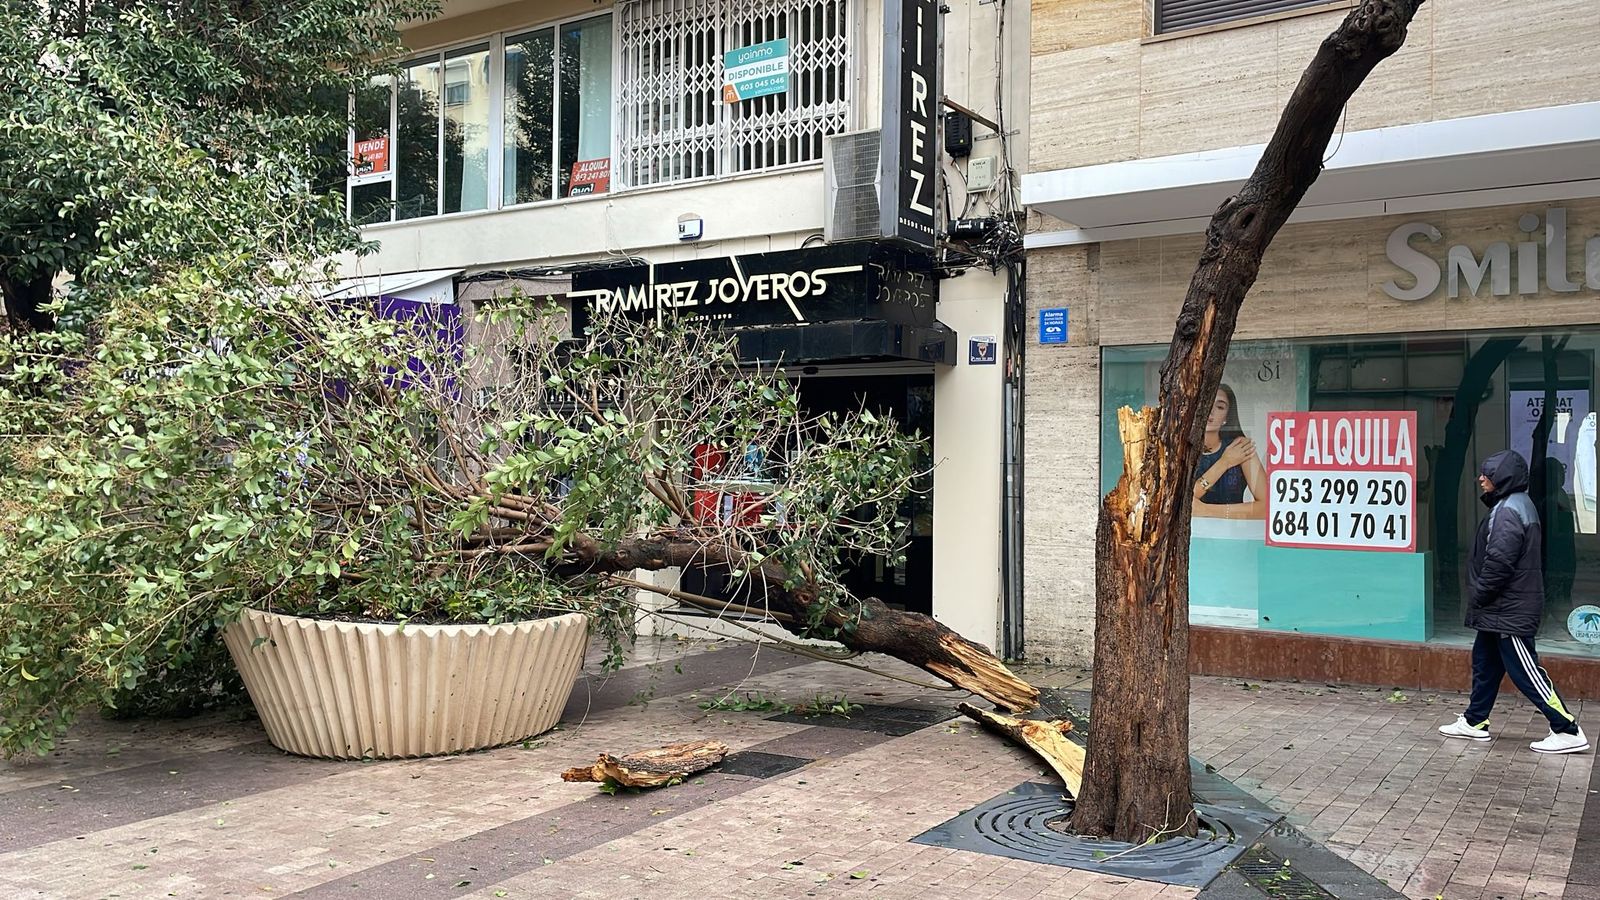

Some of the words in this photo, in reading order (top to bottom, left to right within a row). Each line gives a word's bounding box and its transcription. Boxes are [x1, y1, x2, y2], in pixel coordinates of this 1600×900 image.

[738, 47, 773, 63] yainmo
[728, 62, 784, 80] DISPONIBLE
[740, 83, 753, 91] 603
[754, 79, 769, 88] 045
[770, 76, 785, 85] 046
[358, 140, 385, 153] VENDE
[580, 160, 609, 172] ALQUILA
[1270, 418, 1296, 465] SE
[1303, 417, 1414, 467] ALQUILA
[1276, 477, 1313, 503] 953
[1320, 479, 1359, 505] 299
[1367, 479, 1407, 506] 250
[1272, 510, 1309, 537] 684
[1316, 512, 1339, 538] 01
[1350, 513, 1376, 539] 70
[1383, 514, 1407, 541] 41
